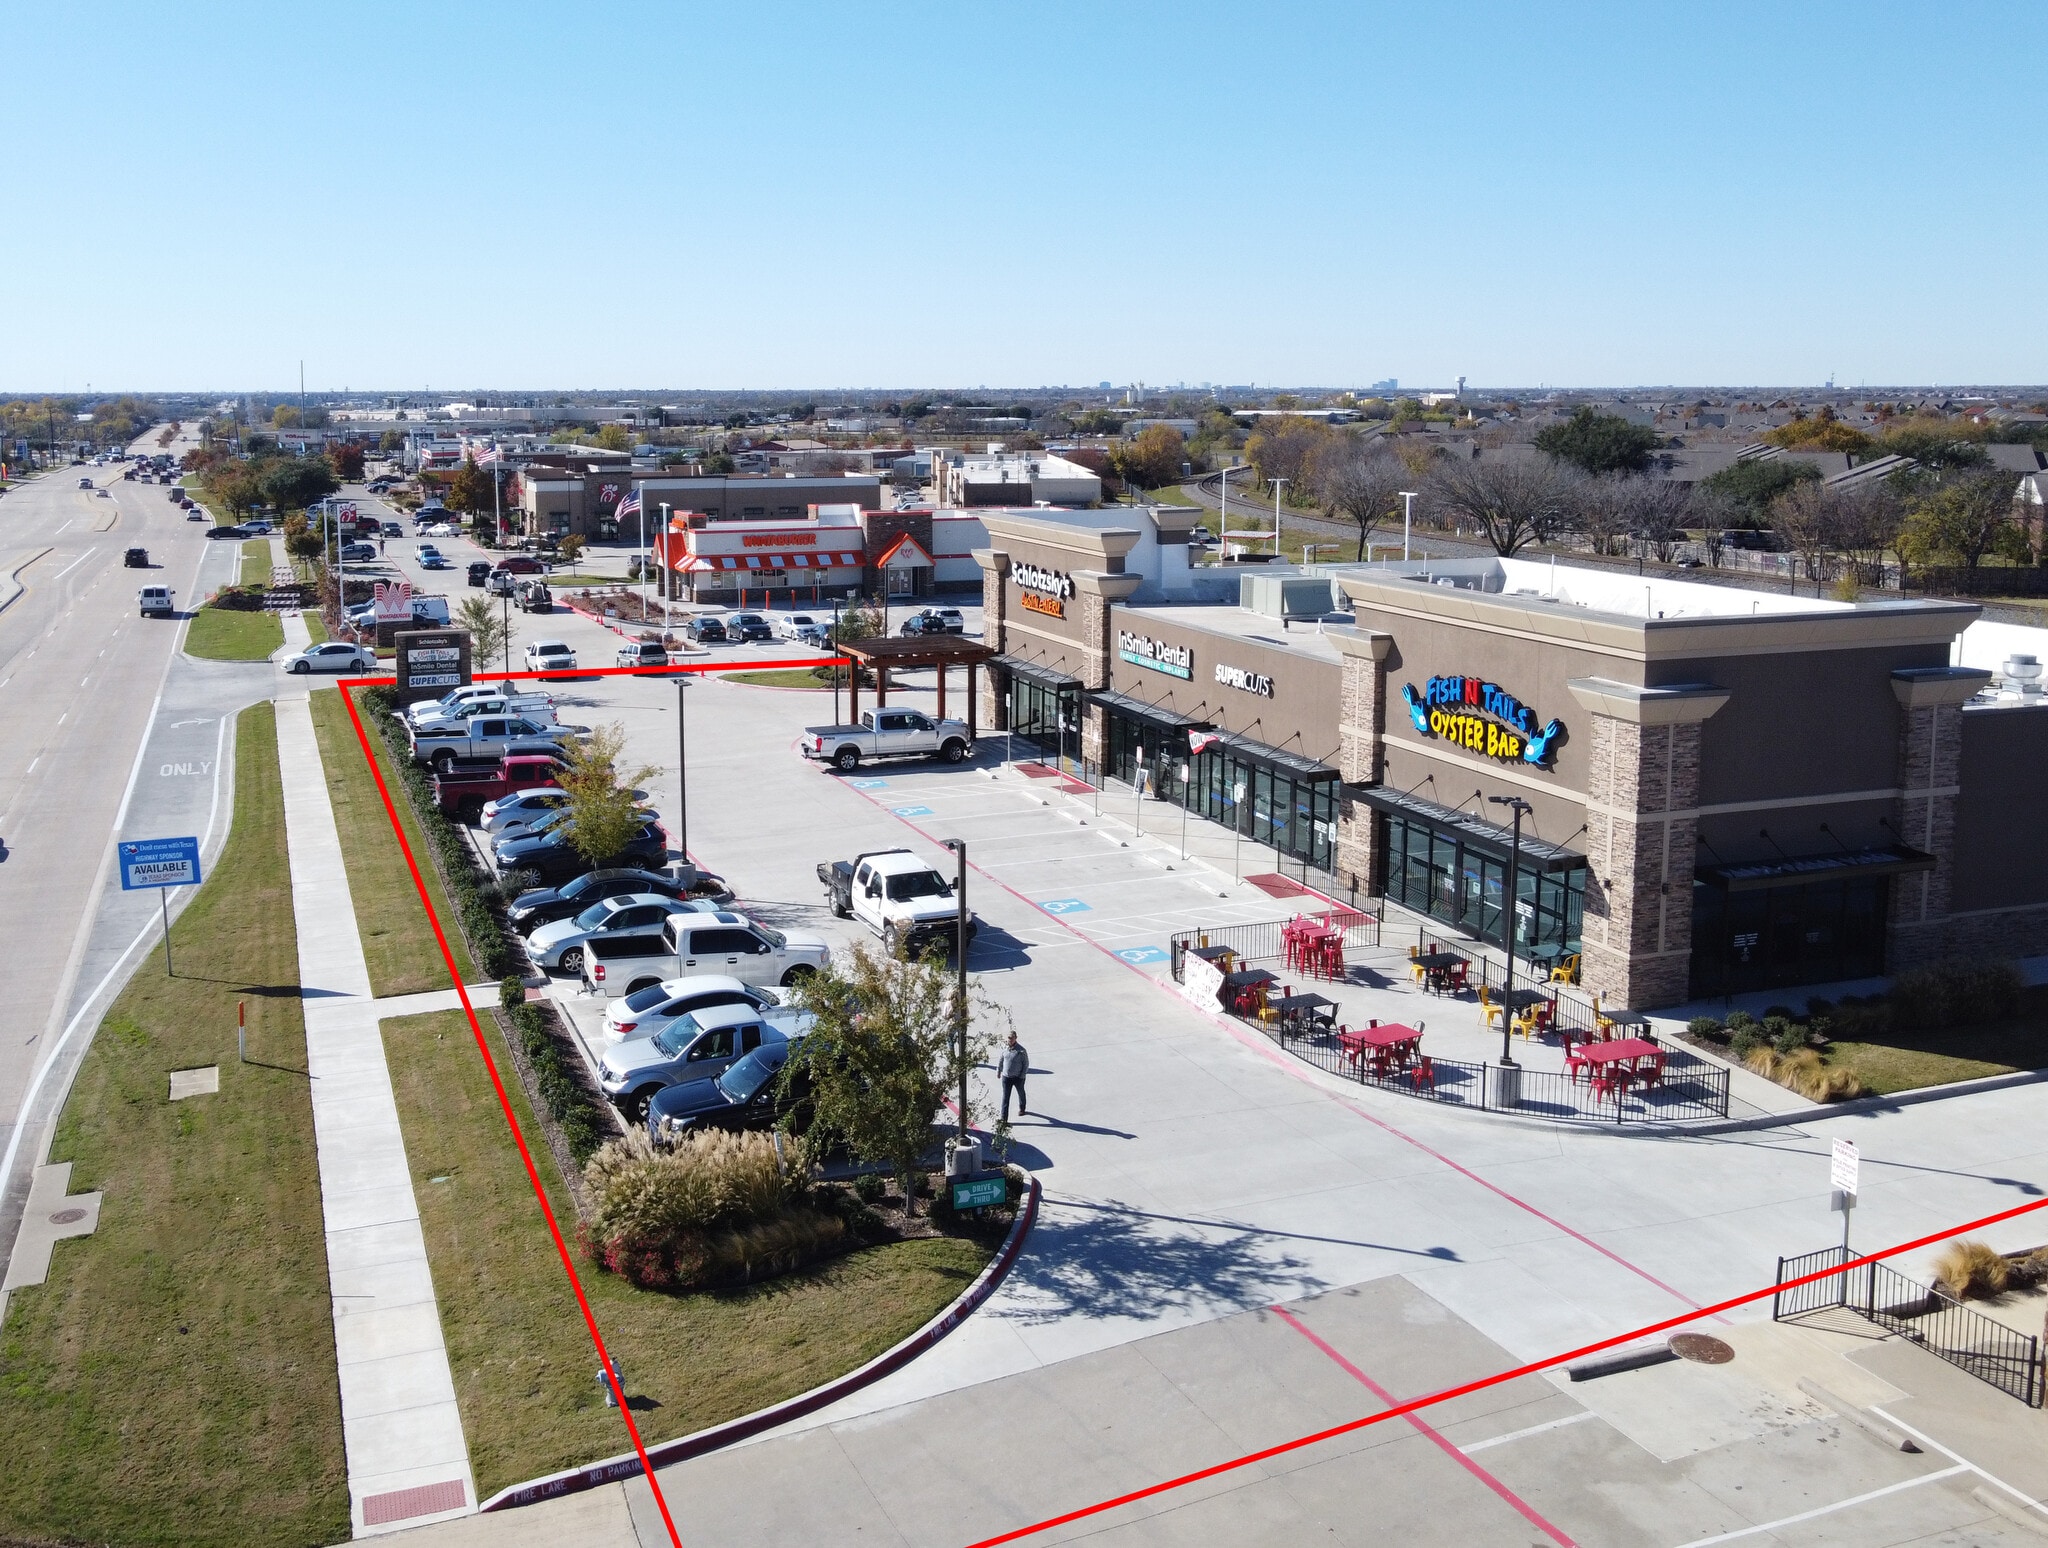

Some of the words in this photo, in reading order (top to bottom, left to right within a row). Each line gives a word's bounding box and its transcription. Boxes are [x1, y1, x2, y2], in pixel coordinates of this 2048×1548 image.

[743, 533, 817, 547] WHATABURGER
[1011, 562, 1070, 598] Schlotzsky's
[1118, 629, 1154, 657] InSmile
[1155, 640, 1190, 668] Dental
[410, 675, 460, 686] SUPERCUTS
[1214, 664, 1270, 695] SUPERCUTS
[1426, 676, 1463, 705] FISH
[1465, 678, 1481, 705] N
[1482, 684, 1528, 732] TAILS
[1430, 710, 1484, 751] OYSTER
[1487, 723, 1520, 756] BAR
[160, 761, 212, 777] ONLY
[135, 853, 158, 862] HIGHWAY
[159, 852, 184, 860] SPONSOR
[134, 861, 188, 875] AVAILABLE
[1833, 1139, 1858, 1155] RESERVED
[1835, 1147, 1857, 1161] PARKING
[972, 1183, 992, 1193] DRIVE
[973, 1194, 991, 1204] THRU
[514, 1487, 537, 1503] FIRE
[541, 1479, 568, 1496] LANE
[589, 1469, 603, 1483] NO
[607, 1458, 646, 1478] PARKIN
